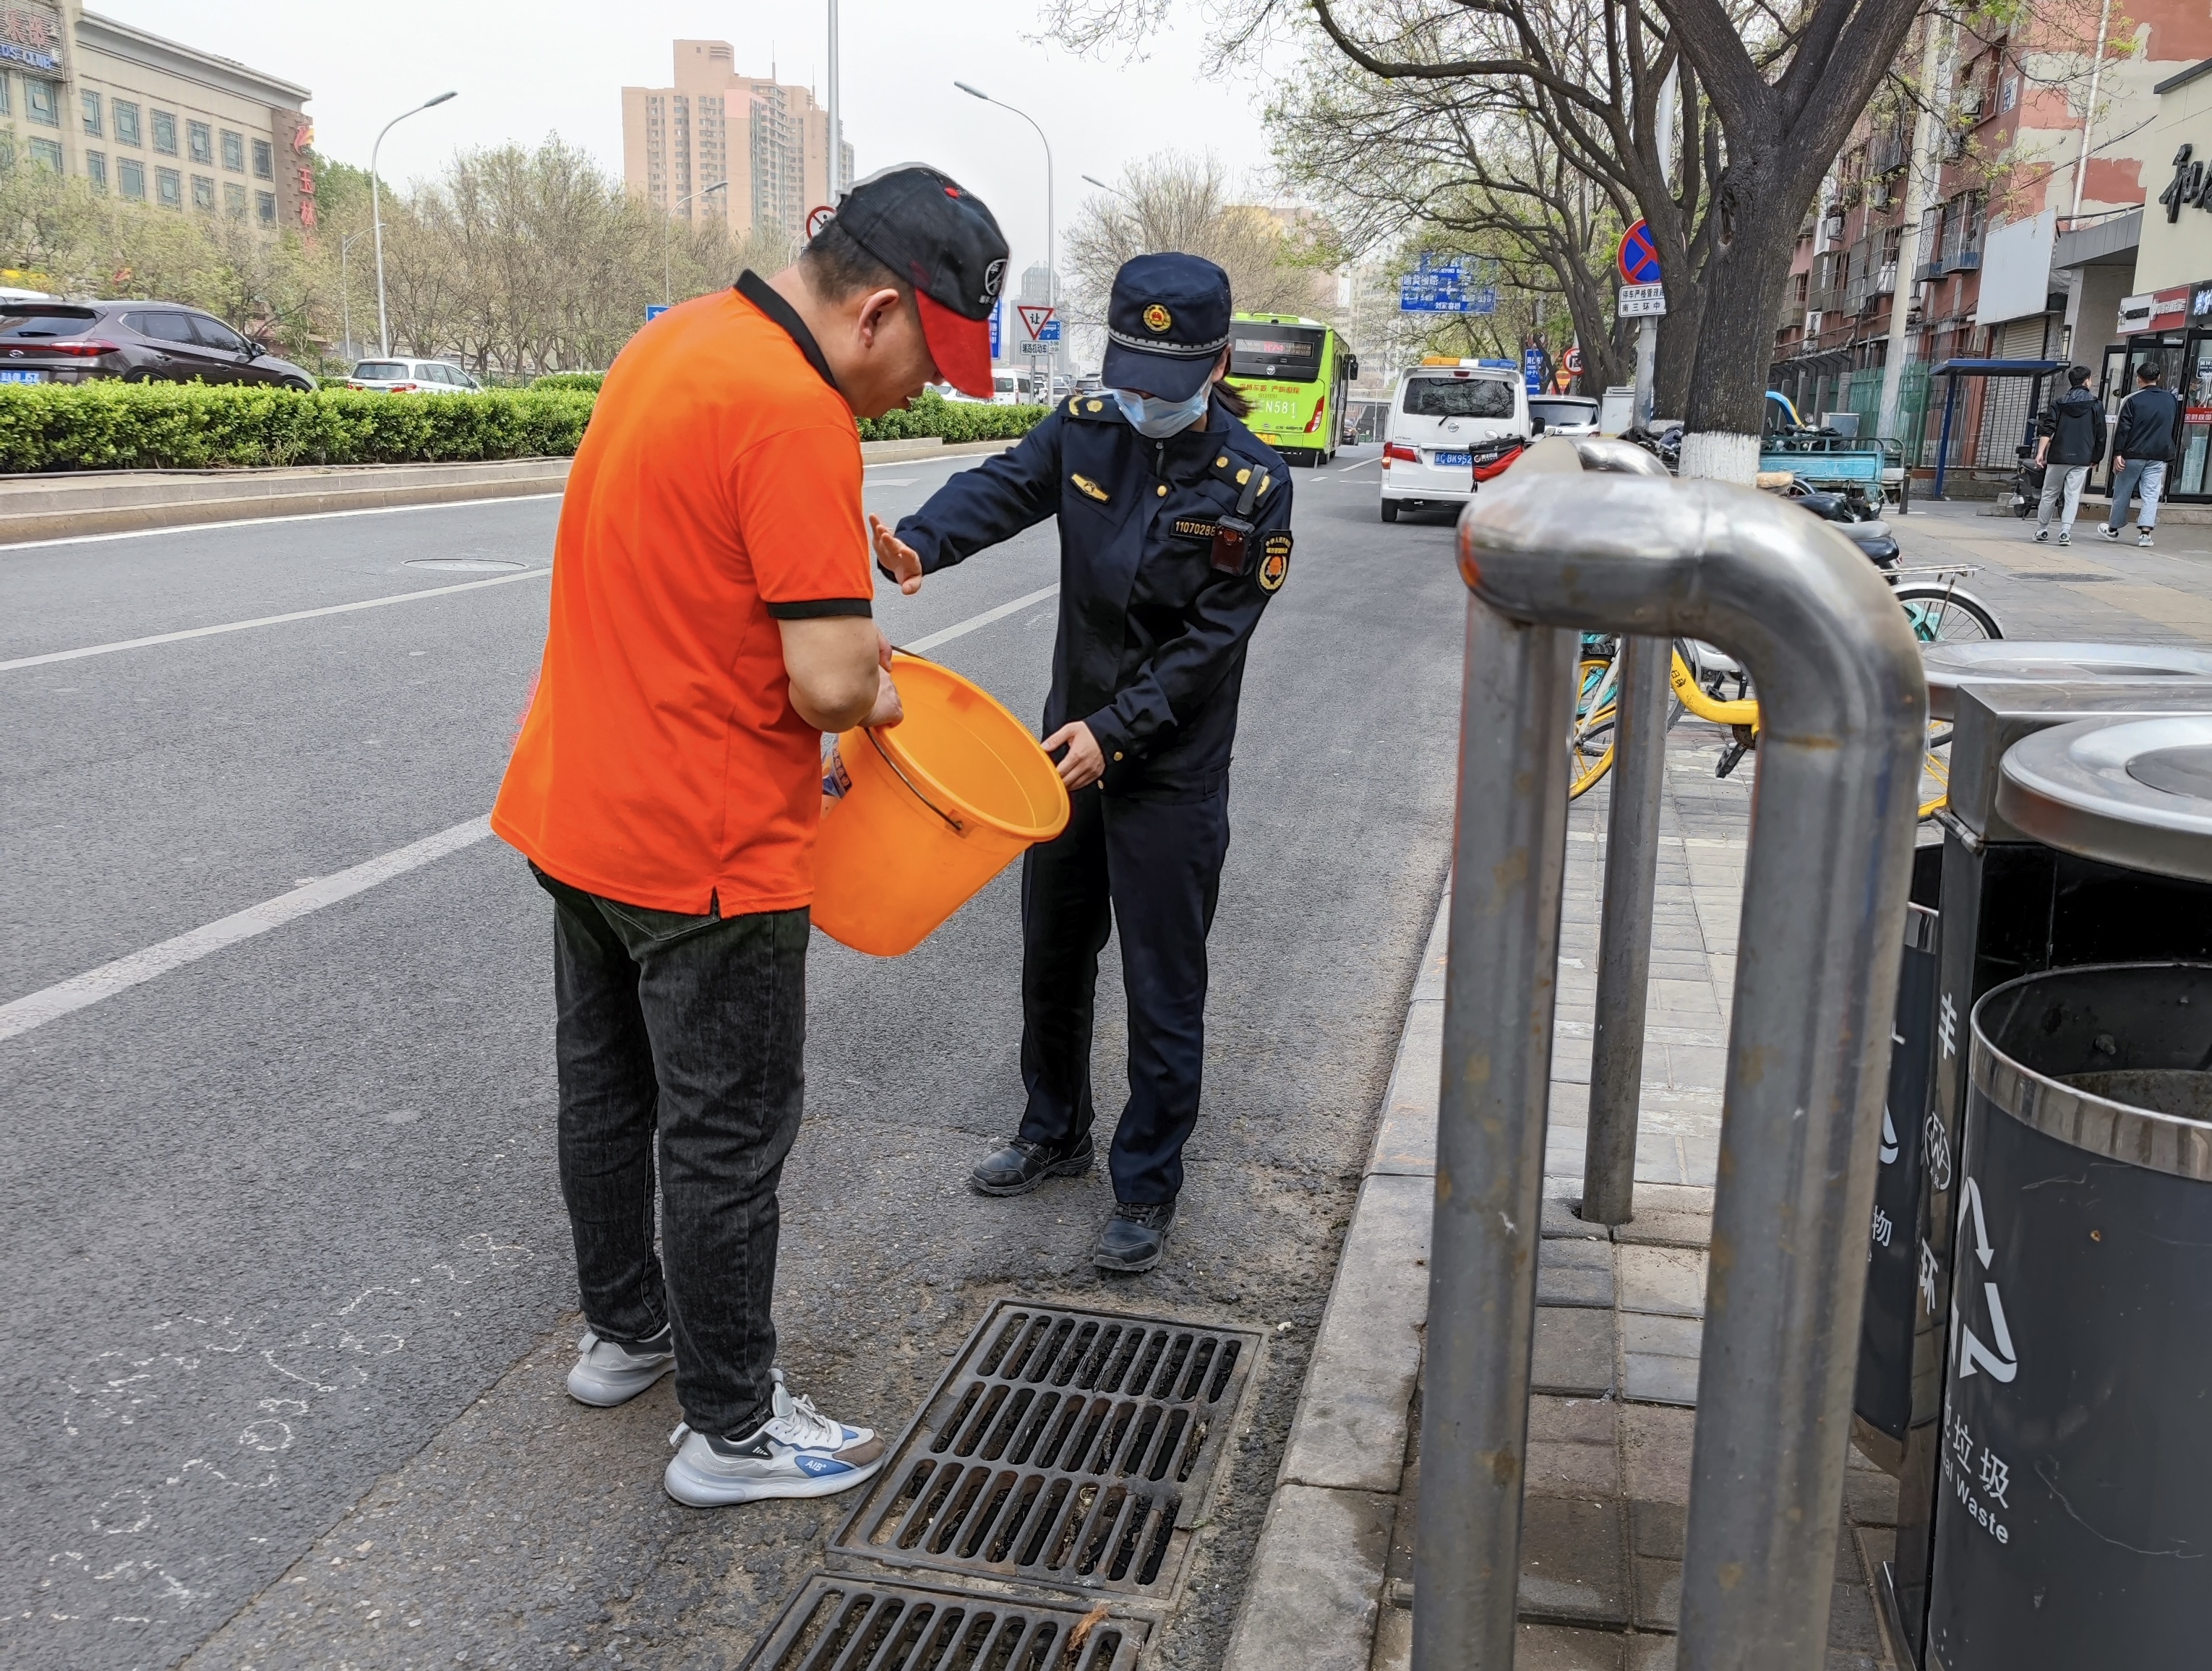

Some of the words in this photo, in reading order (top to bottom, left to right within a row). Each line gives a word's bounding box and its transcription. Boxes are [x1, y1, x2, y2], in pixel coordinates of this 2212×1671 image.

[1029, 313, 1040, 325] 让
[1622, 301, 1666, 312] 南三环中
[1872, 1204, 1892, 1247] 物
[1920, 1237, 1938, 1316] 环
[1956, 1472, 2009, 1544] Waste
